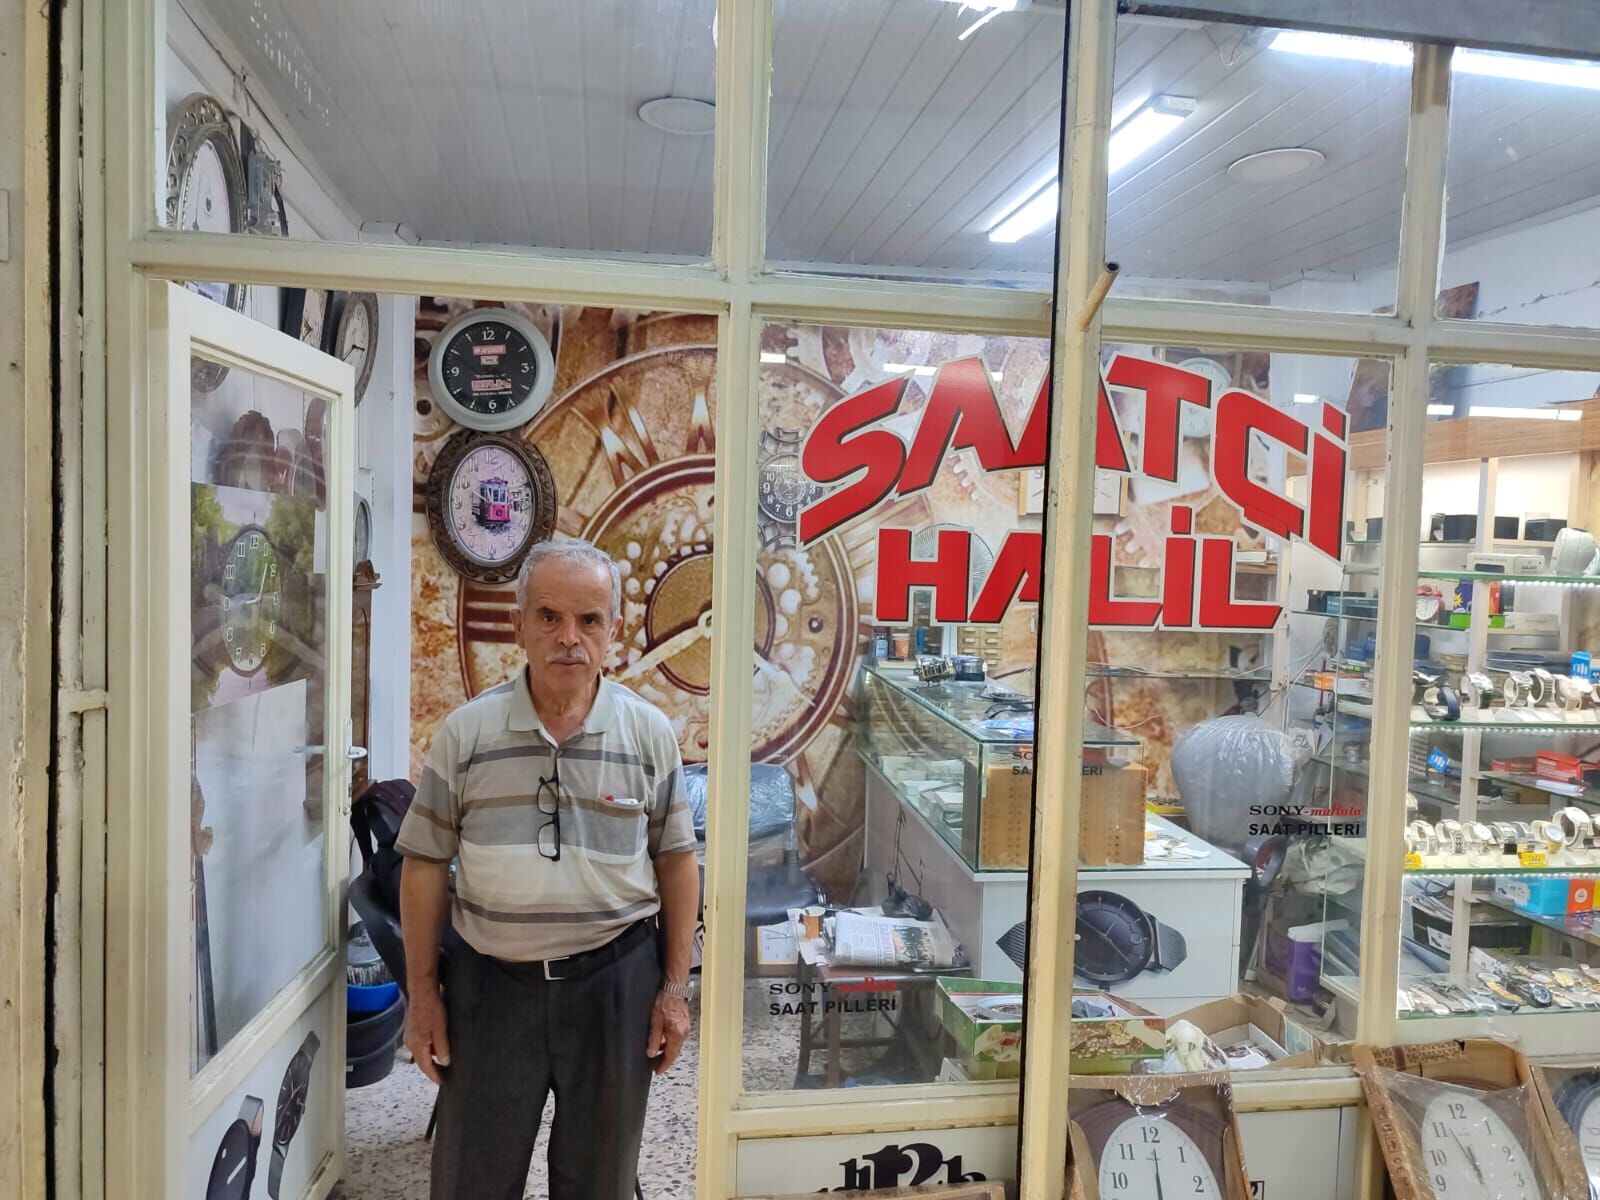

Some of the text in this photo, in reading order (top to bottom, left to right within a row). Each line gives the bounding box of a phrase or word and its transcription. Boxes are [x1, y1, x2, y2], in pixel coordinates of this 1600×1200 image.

[482, 330, 495, 340] 12
[451, 367, 459, 376] 9
[521, 363, 530, 373] 3
[489, 400, 497, 409] 6
[763, 482, 770, 494] 9
[786, 506, 793, 517] 6
[1249, 823, 1293, 836] SAAT
[769, 1002, 818, 1016] SAAT
[1447, 1103, 1468, 1120] 12
[1141, 1127, 1161, 1144] 12
[1432, 1122, 1449, 1138] 11
[1483, 1120, 1493, 1136] 1
[1119, 1143, 1136, 1161] 11
[1178, 1147, 1187, 1163] 1
[1430, 1149, 1447, 1166] 10
[1112, 1172, 1128, 1190] 10
[1193, 1176, 1205, 1193] 2
[1435, 1175, 1447, 1191] 9
[1513, 1170, 1525, 1188] 3
